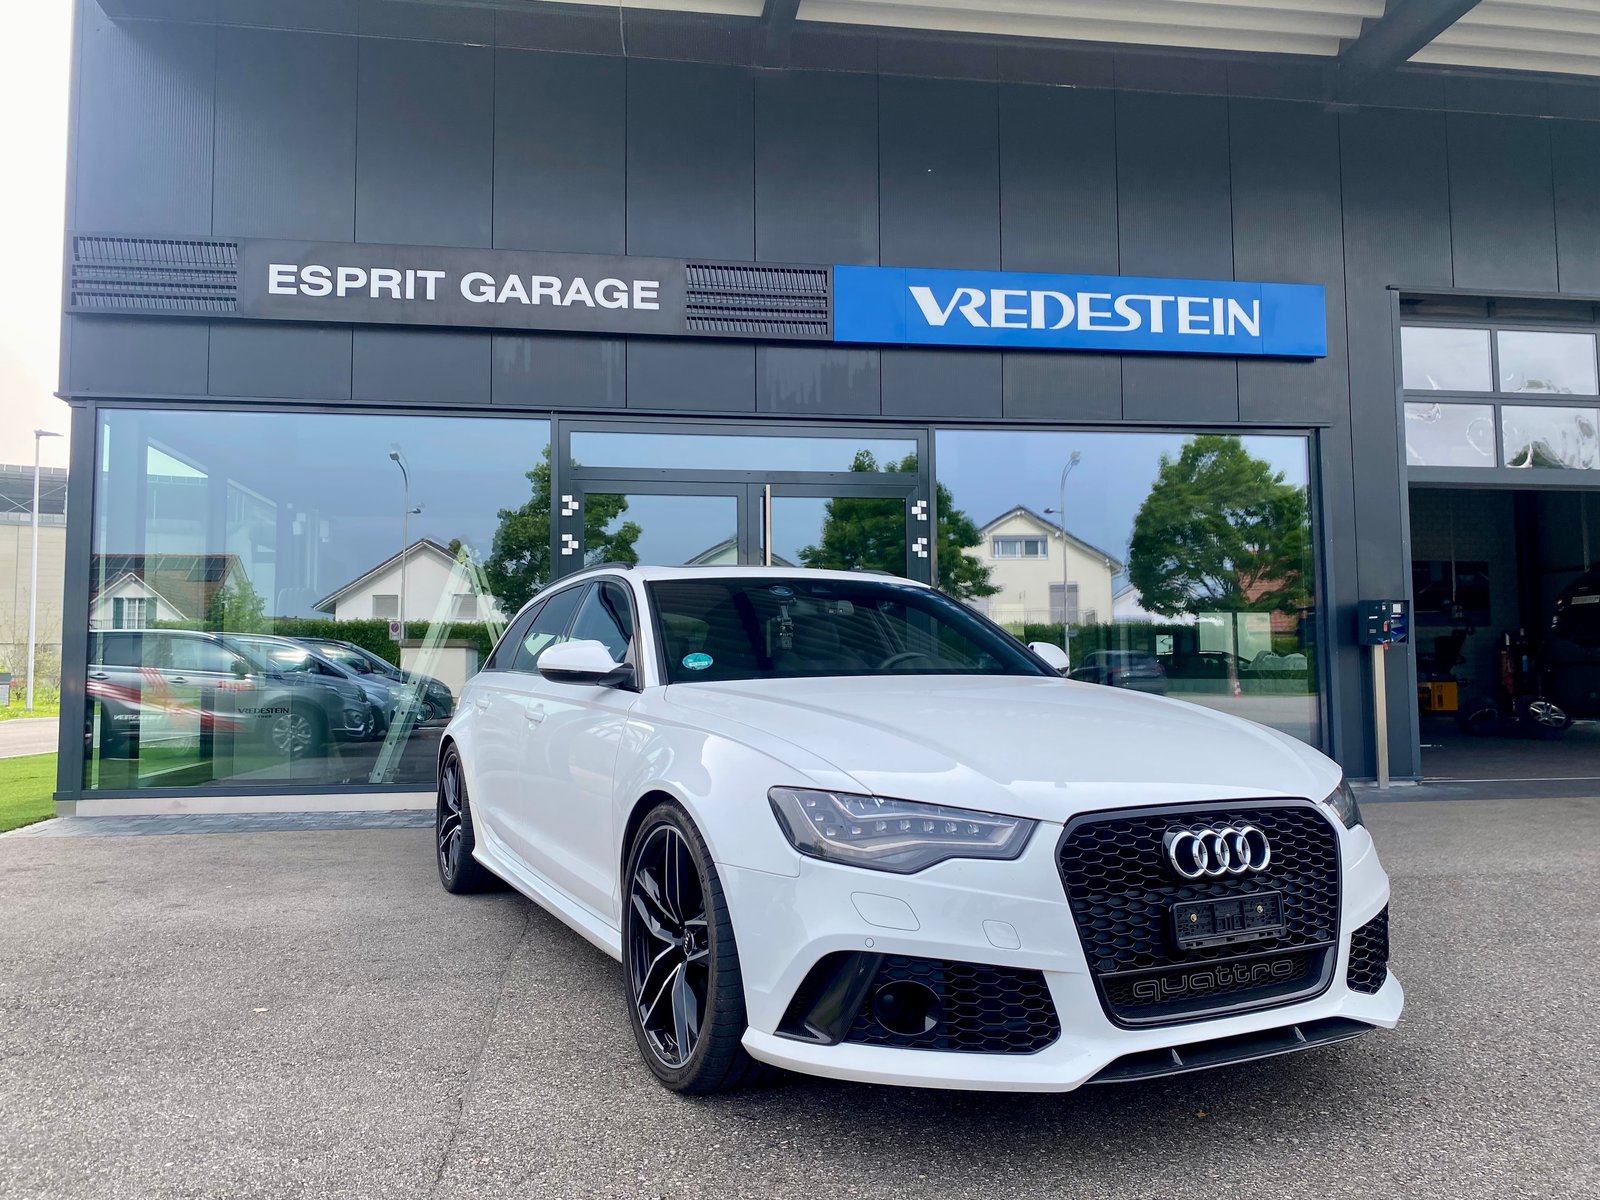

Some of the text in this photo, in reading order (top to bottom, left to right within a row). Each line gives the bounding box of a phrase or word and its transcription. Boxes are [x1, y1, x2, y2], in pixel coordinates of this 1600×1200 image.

[268, 263, 660, 310] ESPRIT GARAGE
[908, 286, 1260, 337] VREDESTEIN
[1133, 959, 1294, 1001] quattro
